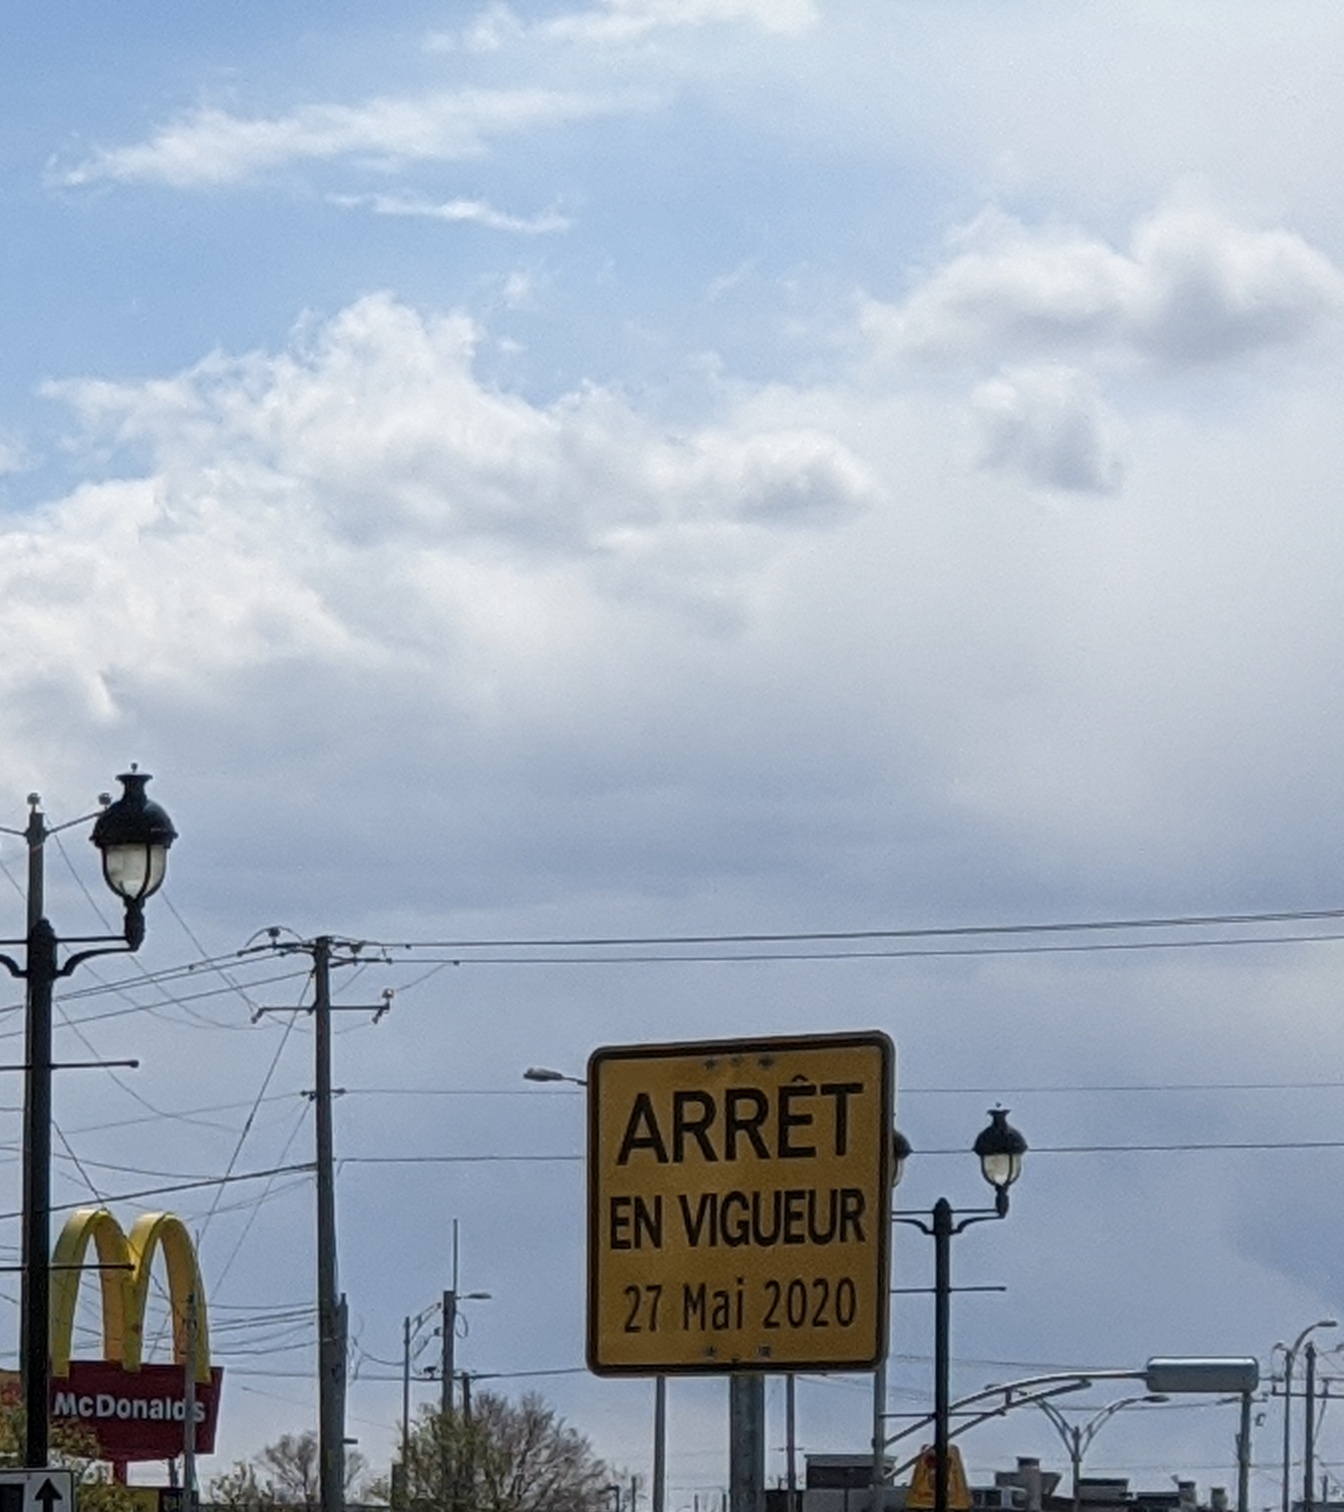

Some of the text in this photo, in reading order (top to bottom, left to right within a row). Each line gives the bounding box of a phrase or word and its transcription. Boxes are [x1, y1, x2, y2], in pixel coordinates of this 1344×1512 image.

[616, 1074, 864, 1166] ARRÊT
[609, 1188, 866, 1250] EN VIGUEUR
[624, 1276, 857, 1333] 27 Mai 2020
[53, 1391, 207, 1423] McDonalds
